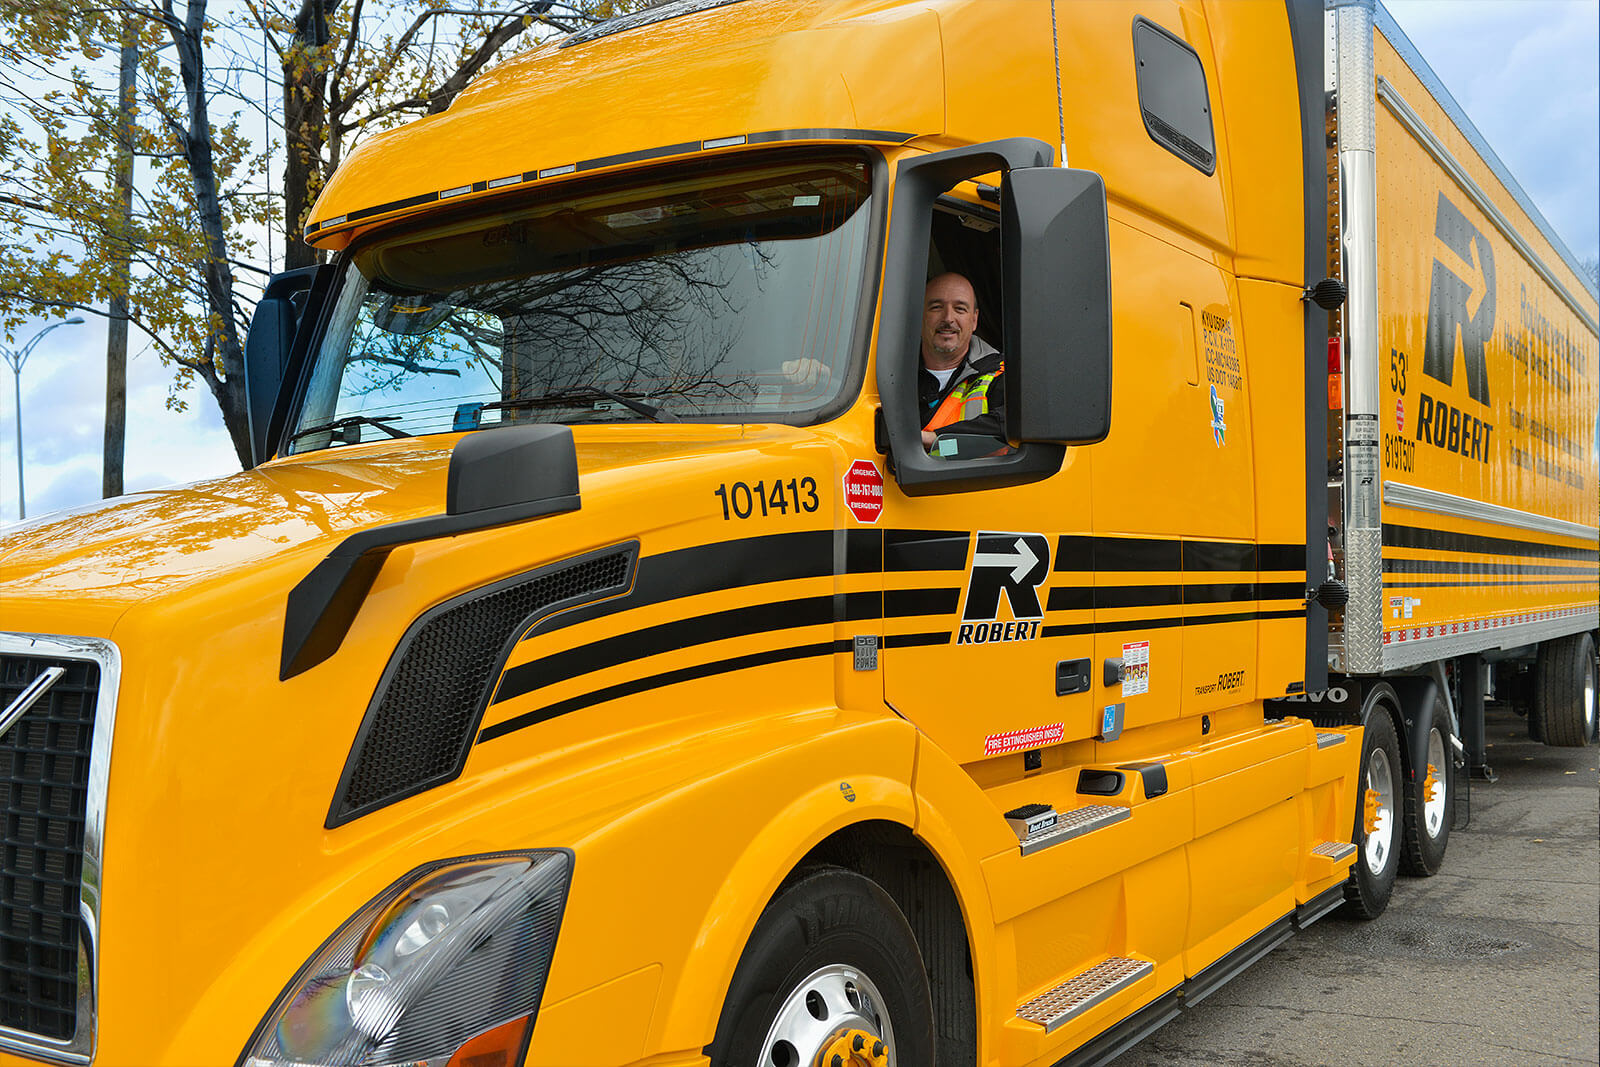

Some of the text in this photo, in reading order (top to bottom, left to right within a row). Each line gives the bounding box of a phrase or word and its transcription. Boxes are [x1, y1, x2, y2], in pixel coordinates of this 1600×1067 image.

[1416, 392, 1493, 464] ROBERT
[1385, 433, 1415, 473] 819T507
[852, 468, 877, 477] URGENCE
[714, 476, 819, 520] 101413
[850, 501, 881, 510] EMERGENCY
[956, 620, 1042, 646] ROBERT
[856, 657, 877, 668] POWER
[1194, 683, 1217, 696] TRANSPORT
[988, 727, 1062, 750] FIRE EXTINGUISHER INSIDE
